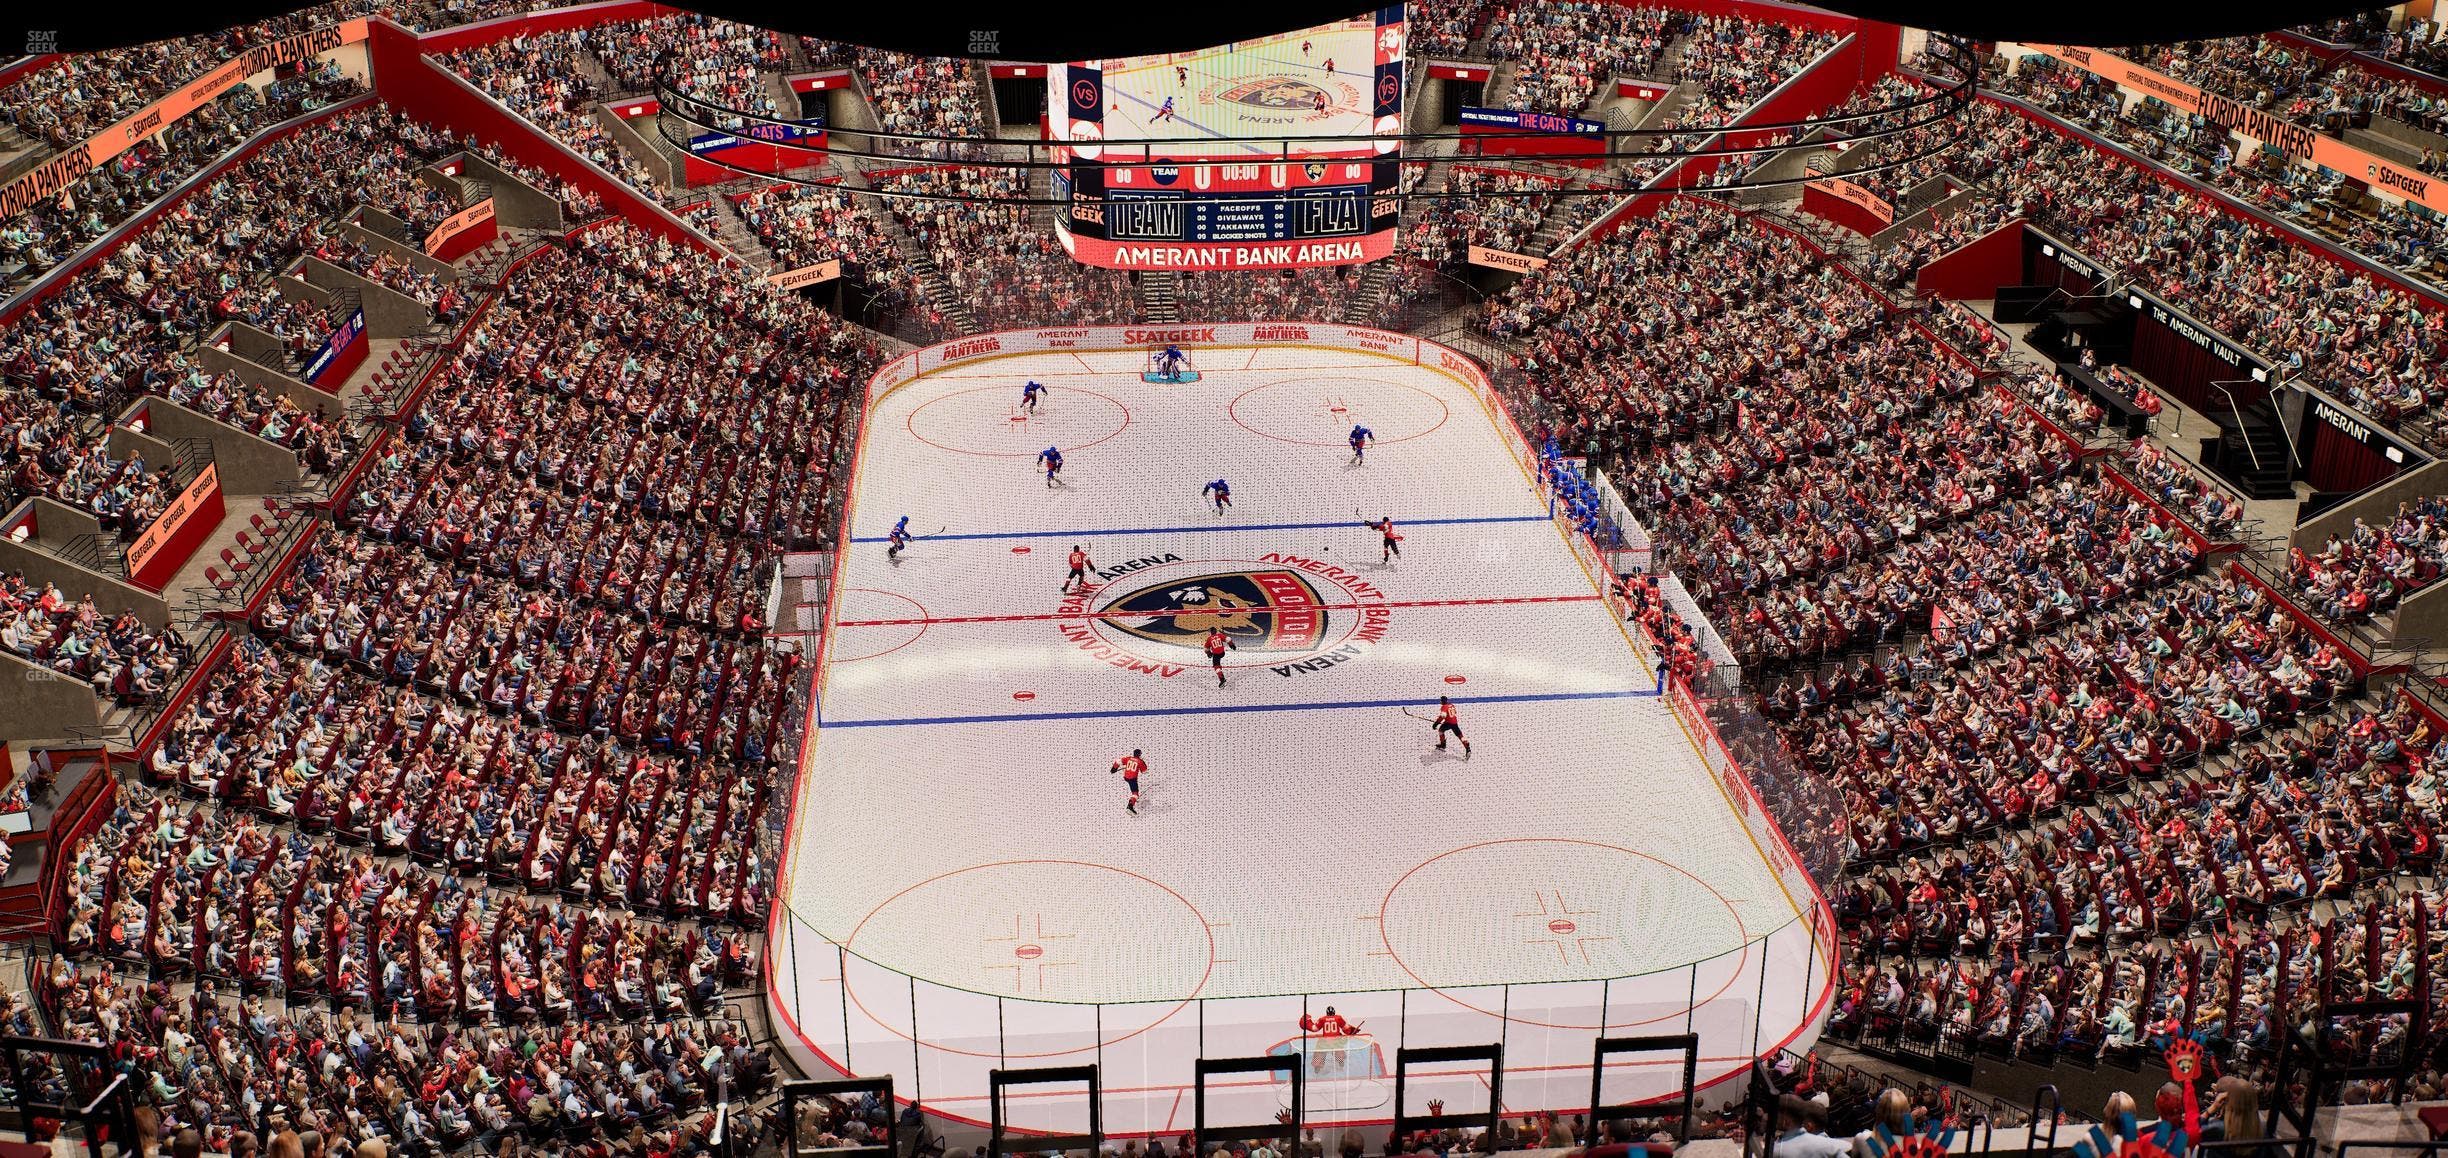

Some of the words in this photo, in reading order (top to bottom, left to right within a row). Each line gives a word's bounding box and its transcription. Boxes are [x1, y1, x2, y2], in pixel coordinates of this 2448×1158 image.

[240, 44, 280, 80] FLORIDA
[280, 25, 342, 64] PANTHERS
[1076, 88, 1094, 101] VS
[1381, 82, 1395, 96] VS
[133, 108, 162, 138] SEATGEEK
[751, 125, 784, 140] CATS
[1518, 113, 1538, 129] THE
[1540, 115, 1568, 132] CATS
[2199, 90, 2246, 134] FLORIDA
[2248, 110, 2315, 160] PANTHERS
[0, 174, 37, 222] ORIDA
[36, 144, 93, 202] PANTHERS
[1116, 168, 1132, 183] 00
[1152, 168, 1178, 176] TEAM
[1194, 159, 1211, 190] 0
[1222, 165, 1259, 180] 00:00
[1271, 157, 1287, 188] 0
[1345, 164, 1361, 179] 00
[2379, 165, 2428, 200] SEATGEEK
[1072, 192, 1103, 210] SEAT
[1373, 186, 1398, 206] SEAT
[1071, 206, 1105, 225] GEEK
[1112, 194, 1181, 236] TEAM
[1304, 190, 1358, 234] FLA
[1371, 201, 1398, 219] GEEK
[1114, 247, 1231, 267] AMERANT
[1236, 246, 1292, 266] BANK
[1297, 241, 1363, 263] ARENA
[1484, 252, 1531, 269] SEATGEEK
[2058, 252, 2092, 279] AMERANT
[1036, 330, 1089, 339] AMERANT
[1124, 328, 1215, 344] SEATGEEK
[1253, 330, 1310, 340] PANTHERS
[1346, 329, 1403, 345] AMERANT
[1360, 340, 1389, 351] BANK
[2153, 306, 2168, 324] THE
[2169, 317, 2211, 349] AMERANT
[2213, 341, 2241, 367] VAULT
[943, 341, 1001, 361] PANTHERS
[2315, 403, 2370, 443] AMERANT
[192, 470, 214, 502] SEATGEEK
[162, 500, 187, 534] SEATGEEK
[131, 531, 157, 567] SEATGEEK
[1071, 554, 1081, 564] 00
[1097, 553, 1183, 582] ARENA
[1259, 553, 1384, 599] AMERANT
[1058, 579, 1103, 614] BANK
[1262, 578, 1310, 643] FLORIDA
[1350, 606, 1391, 645] BANK
[1059, 623, 1186, 678] AMERANT
[1211, 639, 1223, 649] 00
[1270, 643, 1362, 678] ARENA
[1126, 759, 1138, 772] 00
[1324, 1021, 1338, 1033] 00
